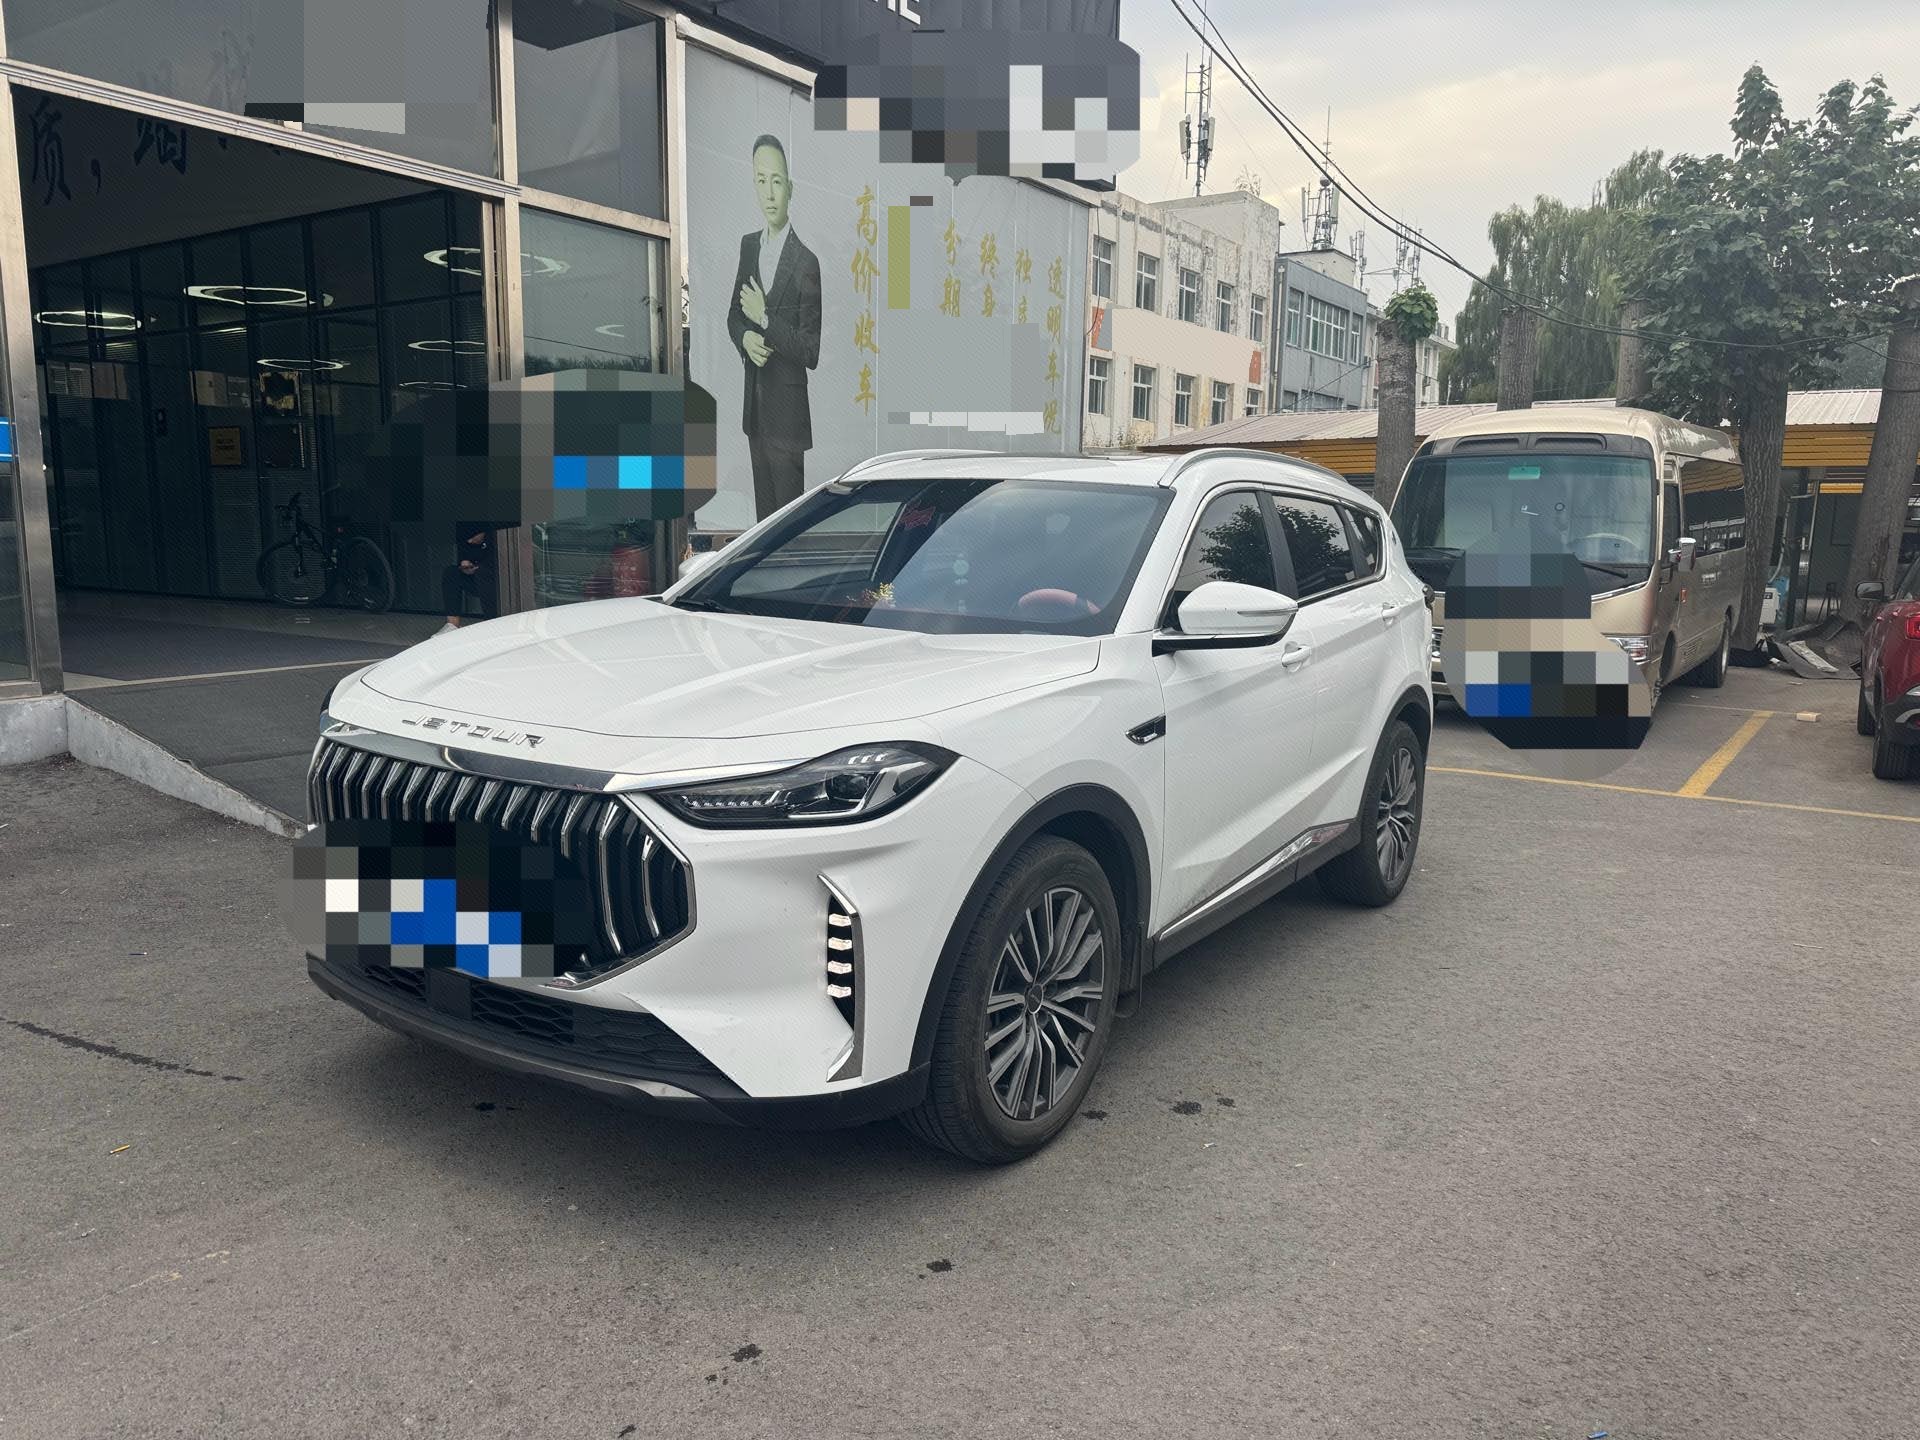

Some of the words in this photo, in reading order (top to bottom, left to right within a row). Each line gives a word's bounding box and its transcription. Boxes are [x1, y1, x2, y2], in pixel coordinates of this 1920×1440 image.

[851, 185, 881, 417] 高价收车
[402, 715, 545, 748] JETOUR
